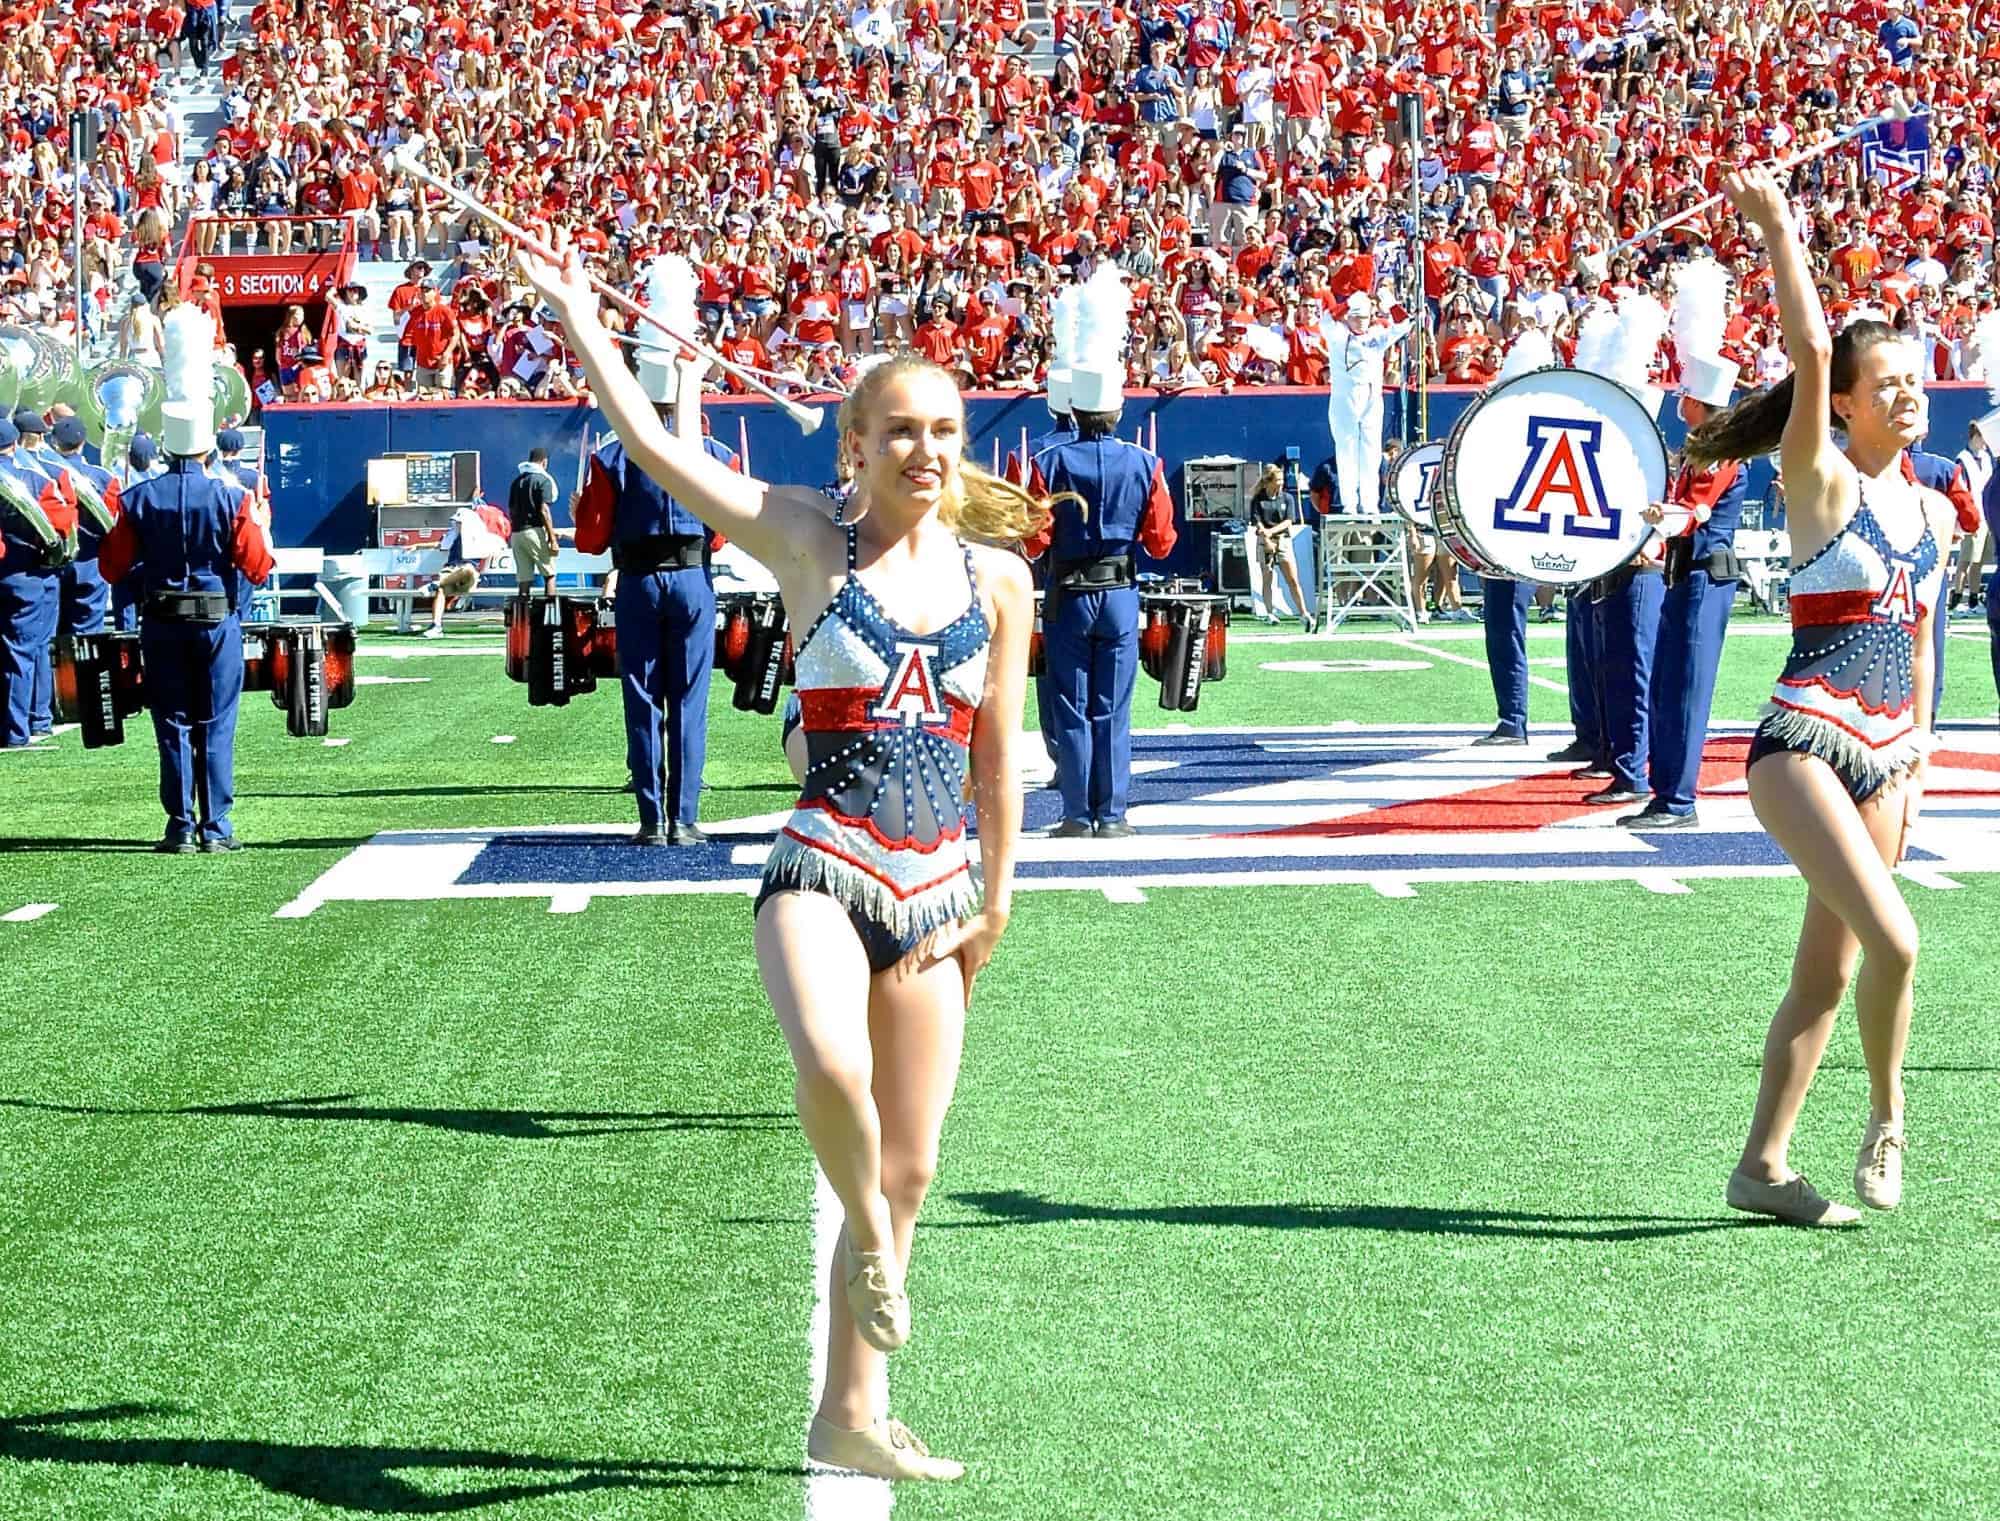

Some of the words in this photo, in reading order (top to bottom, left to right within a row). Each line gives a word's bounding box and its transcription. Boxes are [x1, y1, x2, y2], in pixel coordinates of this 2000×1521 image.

[224, 274, 235, 295] 3
[240, 273, 304, 295] SECTION
[308, 273, 320, 293] 4
[1493, 415, 1622, 540] A
[1870, 558, 1918, 624] A
[552, 631, 563, 651] VIC
[770, 640, 785, 661] VIC
[1191, 638, 1206, 658] VIC
[98, 669, 111, 691] VIC
[308, 661, 320, 682] VIC
[553, 653, 565, 691] FIRTH
[760, 662, 779, 701] FIRTH
[867, 637, 952, 728] A
[1185, 660, 1201, 699] FIRTH
[309, 684, 320, 722] FIRTH
